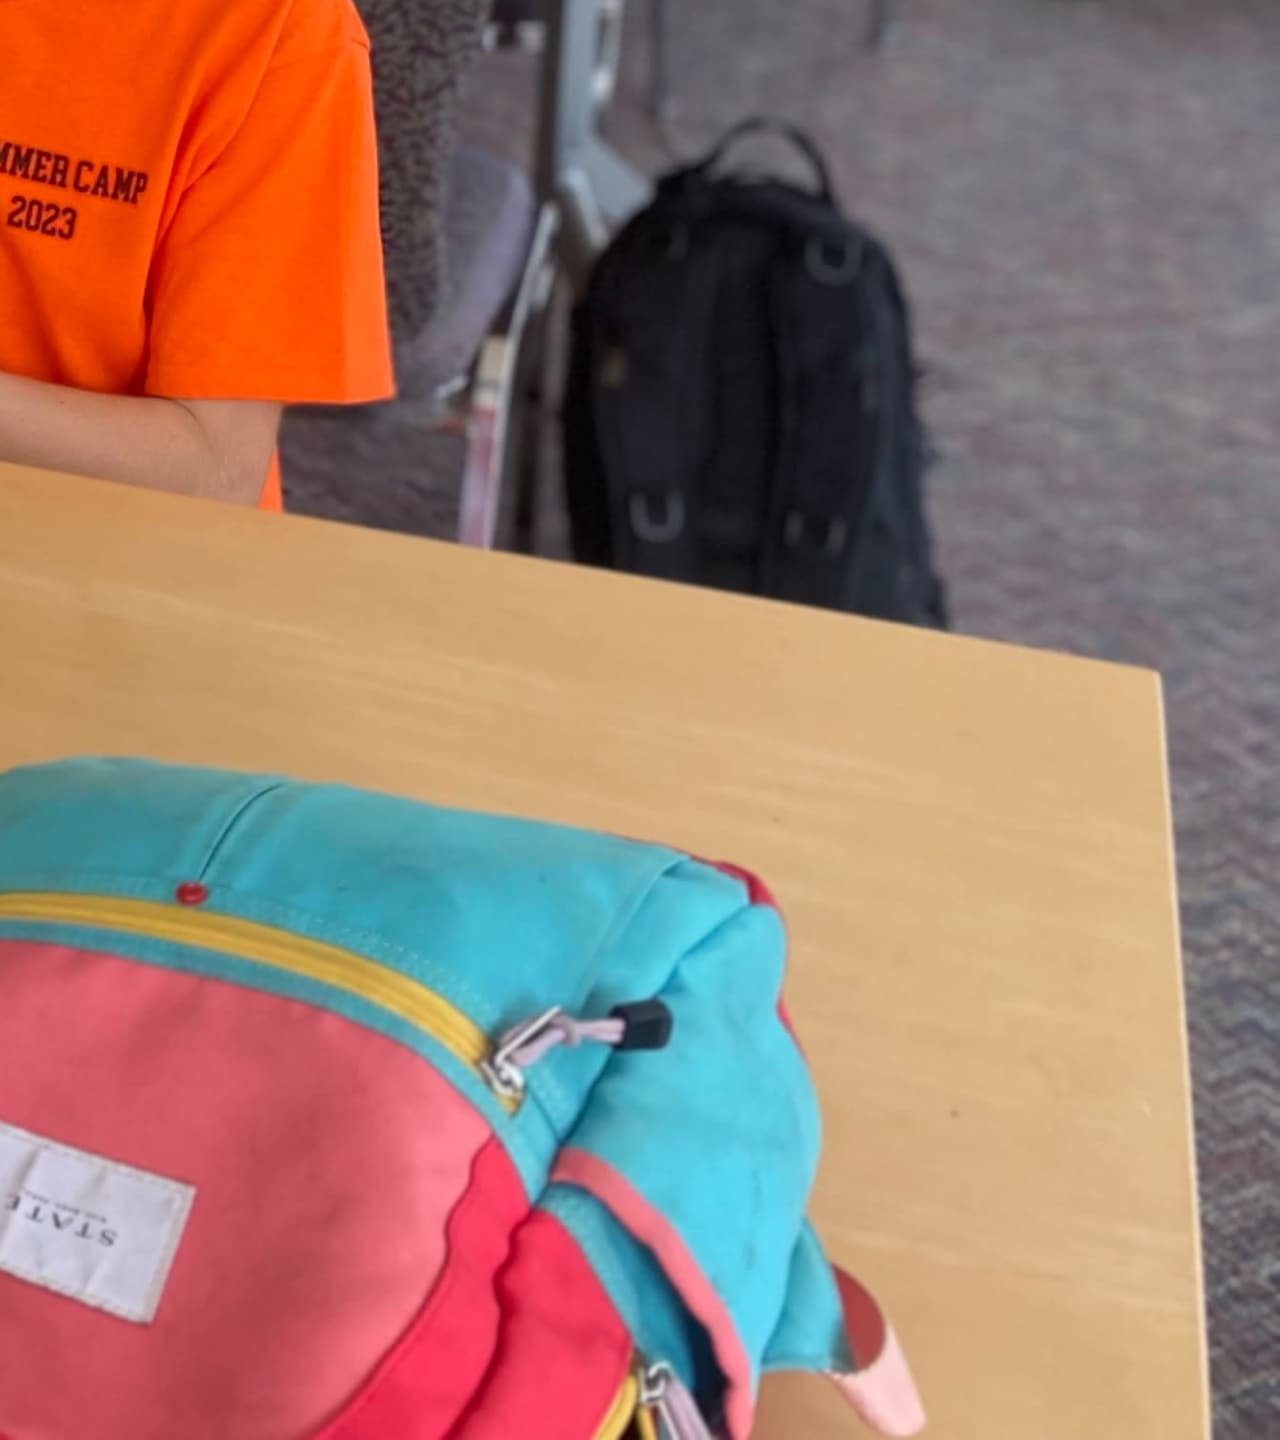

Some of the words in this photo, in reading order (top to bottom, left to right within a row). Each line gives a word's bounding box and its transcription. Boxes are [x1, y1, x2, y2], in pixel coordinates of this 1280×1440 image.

[72, 160, 148, 205] CAMP
[7, 196, 77, 240] 2023
[4, 1193, 118, 1247] STATE
